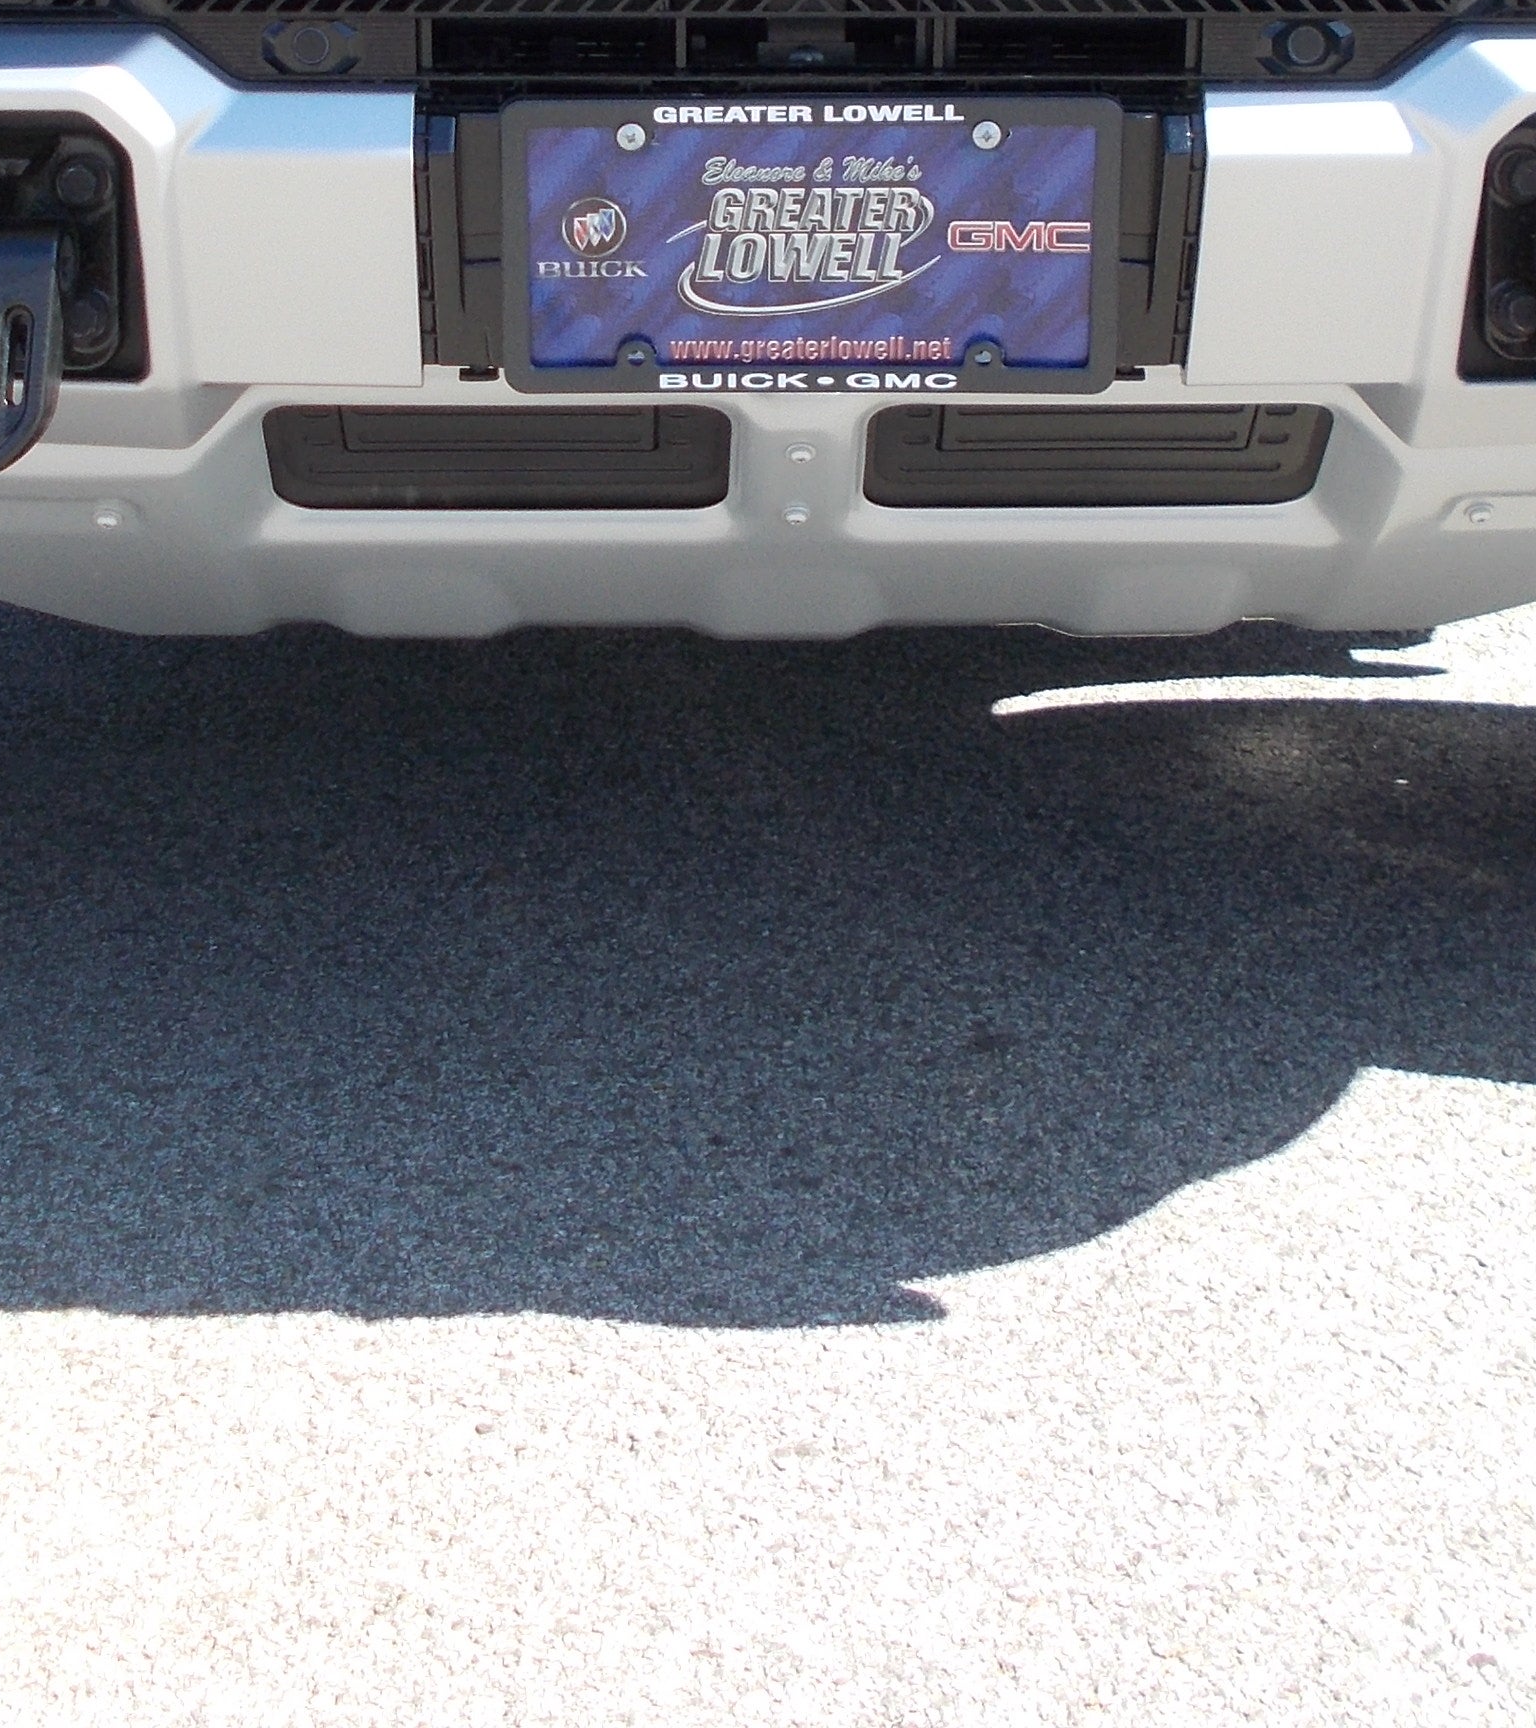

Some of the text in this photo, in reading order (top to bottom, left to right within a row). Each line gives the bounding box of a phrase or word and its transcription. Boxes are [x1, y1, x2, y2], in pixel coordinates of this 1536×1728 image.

[653, 104, 965, 123] GREATER LOWELL
[702, 155, 923, 186] Eleanore & Mike's
[708, 187, 920, 232] GREATER
[947, 220, 1092, 253] GMC
[536, 260, 649, 278] BUICK
[695, 232, 904, 284] LOWELL
[669, 335, 952, 364] www.greaterlowell.net
[658, 372, 959, 390] BUICK GMC
